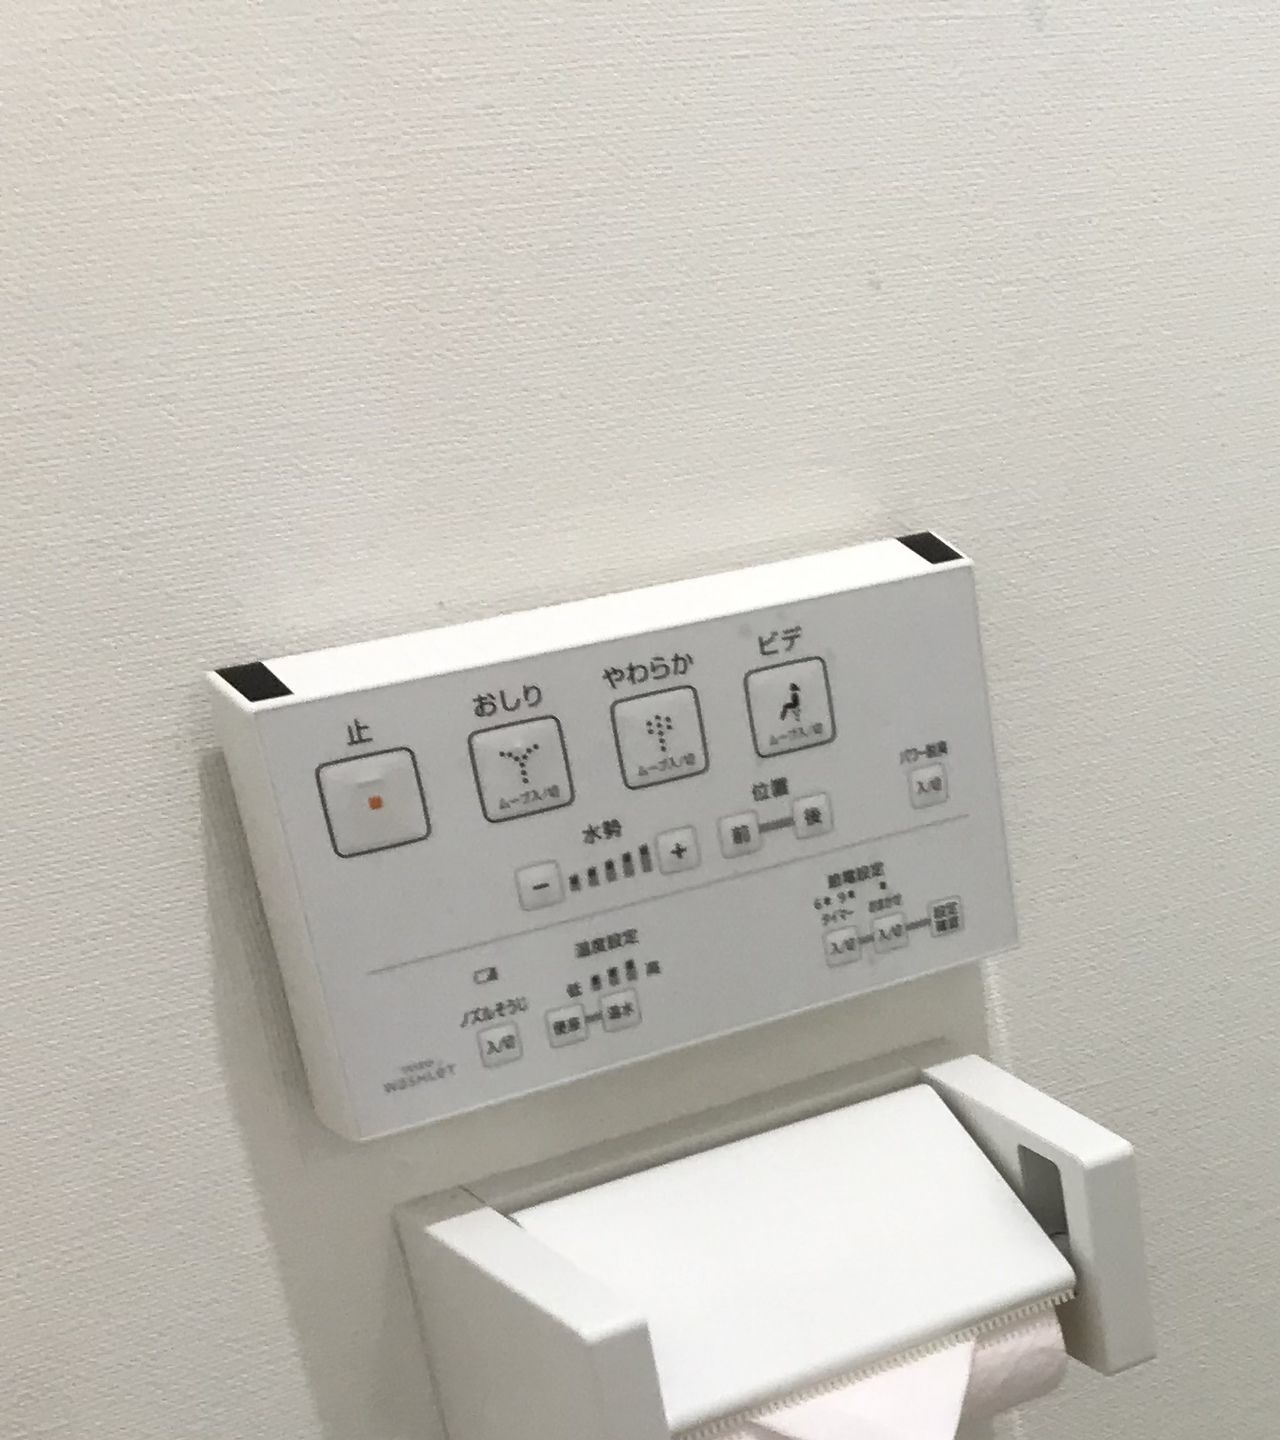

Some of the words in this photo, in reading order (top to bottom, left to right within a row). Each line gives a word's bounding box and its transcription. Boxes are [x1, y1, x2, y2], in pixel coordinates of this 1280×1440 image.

[756, 625, 805, 656] ビデ
[600, 650, 695, 691] やわらか
[470, 682, 543, 718] おしり
[343, 715, 372, 746] 止
[750, 775, 790, 802] 位置
[802, 804, 822, 826] 後
[580, 817, 624, 845] 水勢
[730, 823, 751, 844] 前
